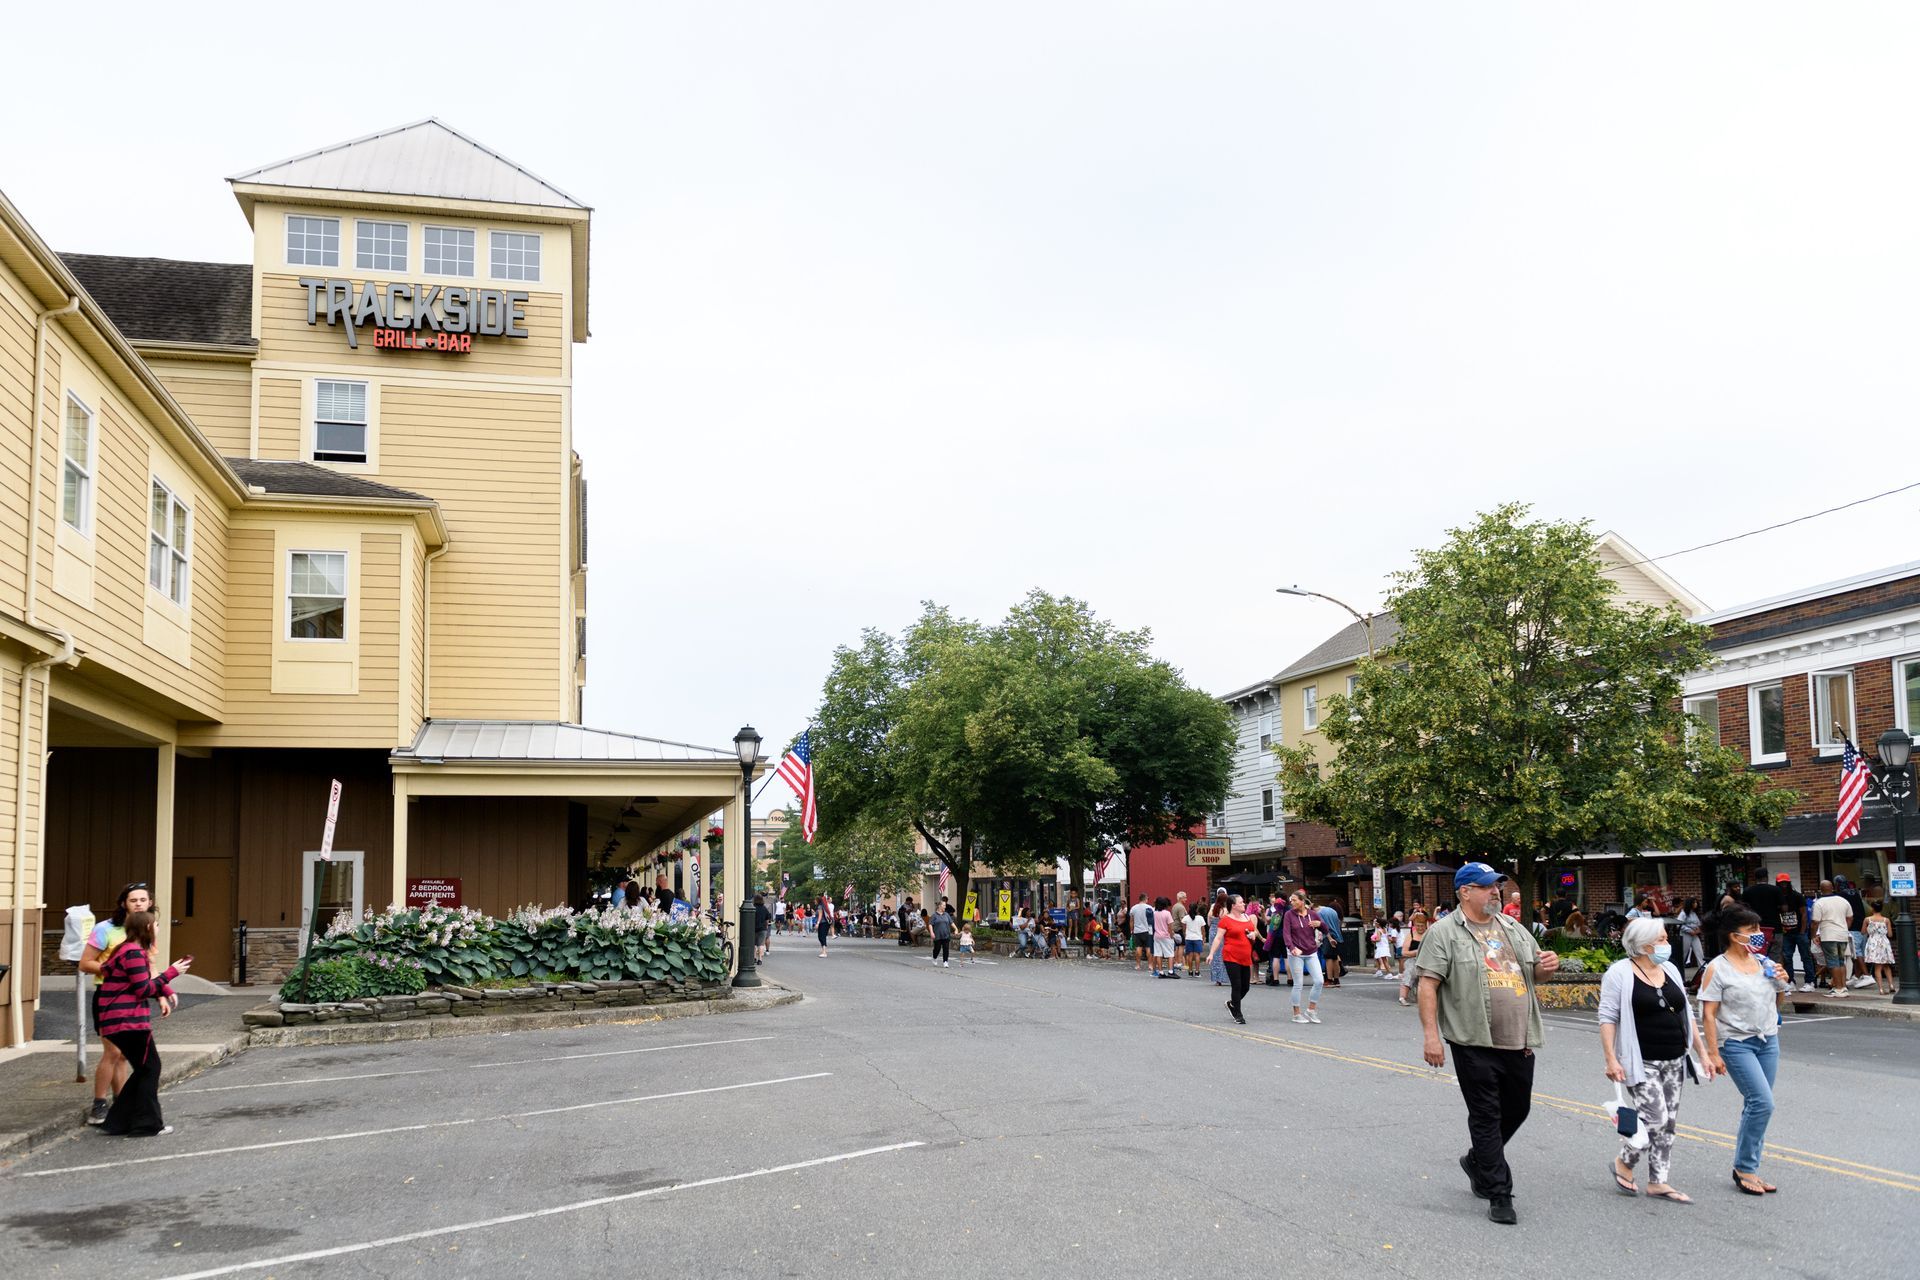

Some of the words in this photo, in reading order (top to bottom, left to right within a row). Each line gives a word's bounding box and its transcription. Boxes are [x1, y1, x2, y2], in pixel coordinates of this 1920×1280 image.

[299, 277, 529, 348] TRACKSIDE
[373, 328, 423, 350] GRILL
[437, 332, 471, 352] BAR
[1196, 847, 1226, 855] BARBER
